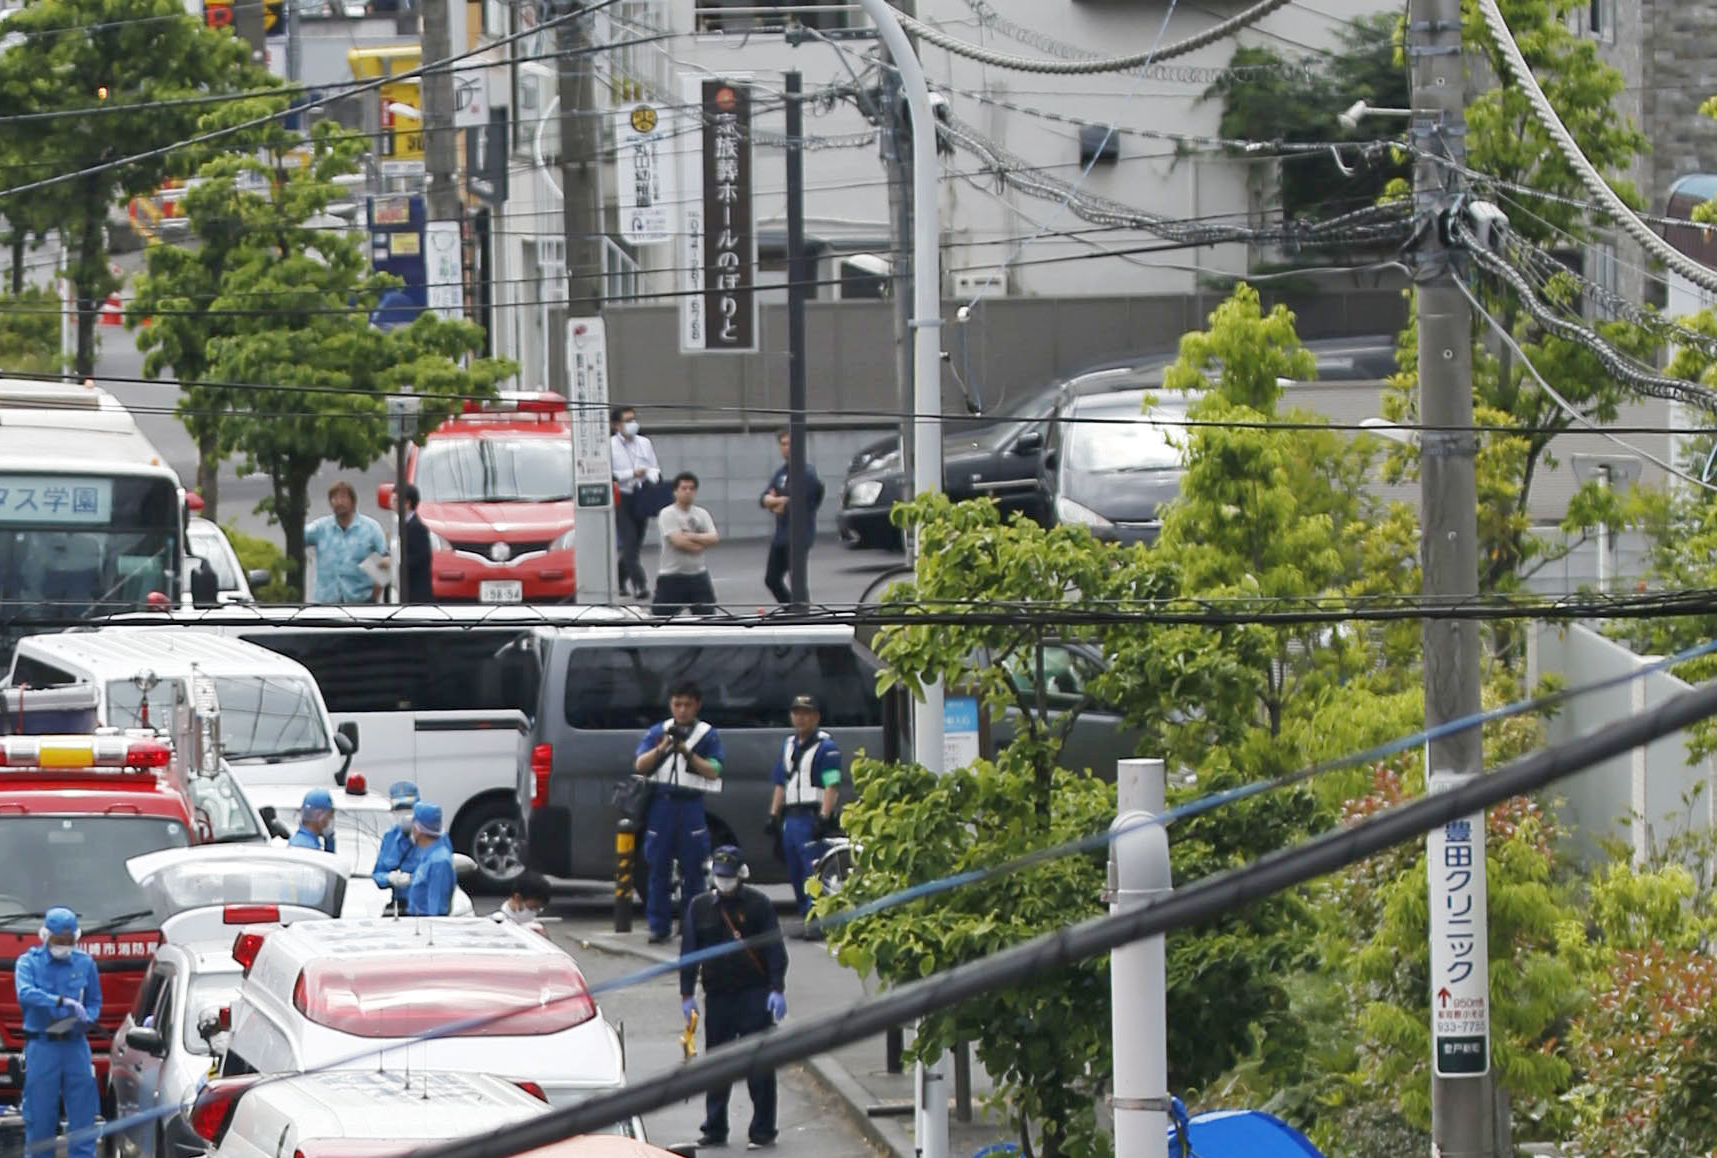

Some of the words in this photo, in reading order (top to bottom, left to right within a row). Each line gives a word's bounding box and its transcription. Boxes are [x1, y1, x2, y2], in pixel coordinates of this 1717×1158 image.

[715, 113, 741, 342] 家族葬ホールのぼりと
[1445, 820, 1474, 984] 豊田クリニック
